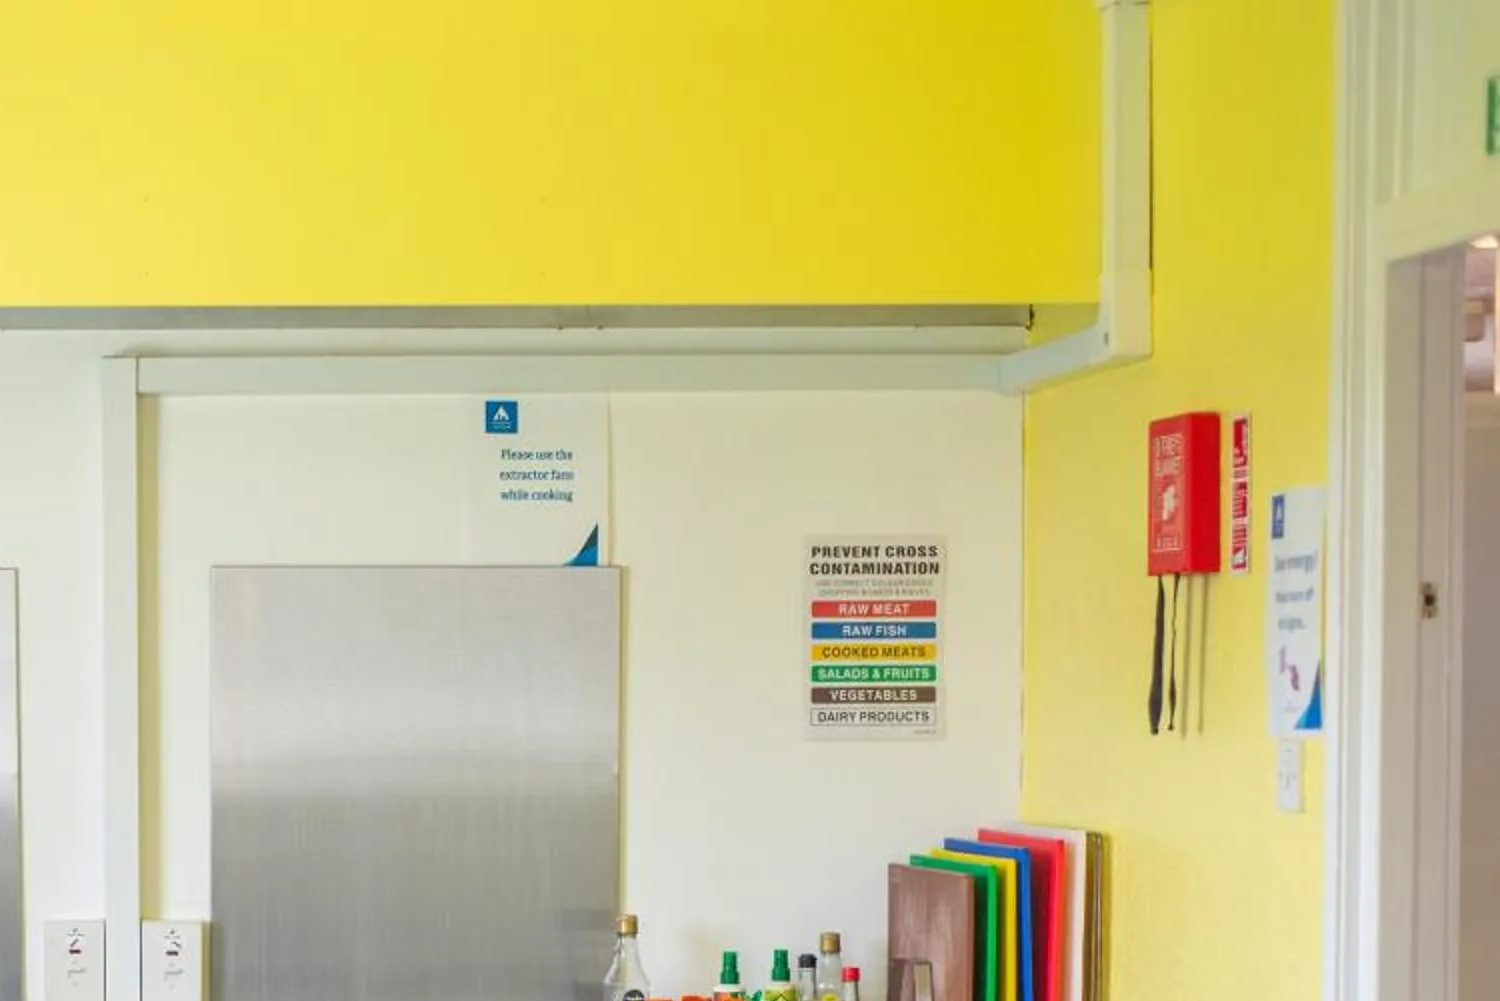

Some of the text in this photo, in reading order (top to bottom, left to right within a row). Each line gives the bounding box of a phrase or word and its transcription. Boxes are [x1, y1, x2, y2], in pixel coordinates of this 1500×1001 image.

[501, 448, 573, 461] Please use the
[499, 470, 550, 481] extractor
[500, 488, 573, 502] while cooking
[811, 545, 938, 558] PREVENT CROSS
[809, 562, 940, 575] CONTAMINATION
[838, 603, 911, 615] RAW MEAT
[842, 625, 908, 637] RAW FISH
[821, 646, 927, 659] COOKED MEATS
[818, 667, 931, 680] SALADS & FRUITS
[829, 689, 918, 701] VEGETABLES
[817, 711, 931, 722] DAIRY PRODUCTS
